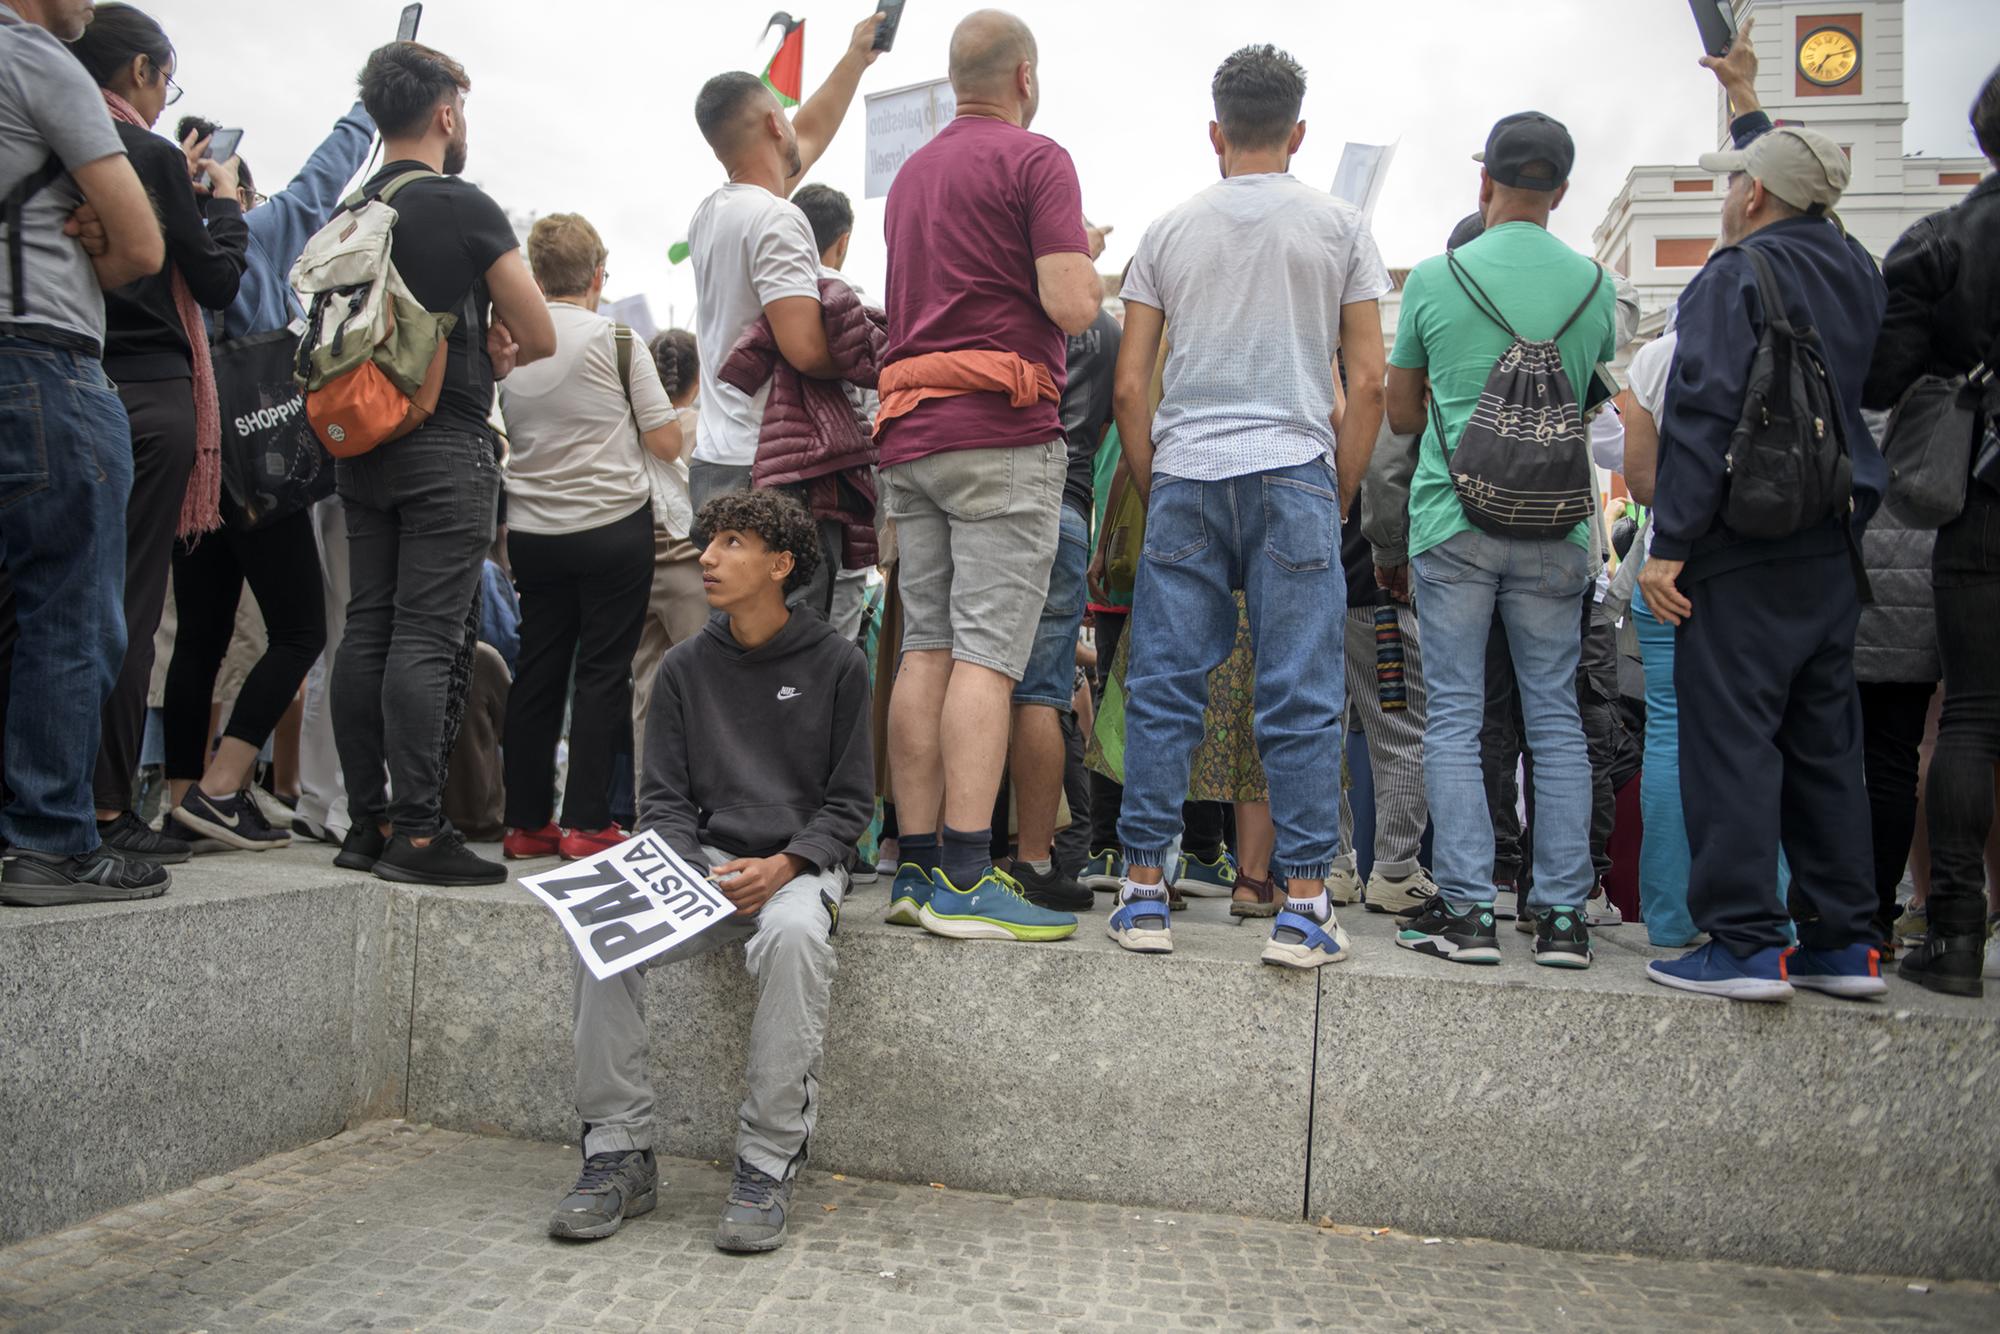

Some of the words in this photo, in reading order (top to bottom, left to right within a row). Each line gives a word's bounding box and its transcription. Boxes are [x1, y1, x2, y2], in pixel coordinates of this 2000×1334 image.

[235, 394, 303, 436] SHOPPIN
[537, 860, 677, 965] PAZ
[623, 841, 714, 921] JUSTA
